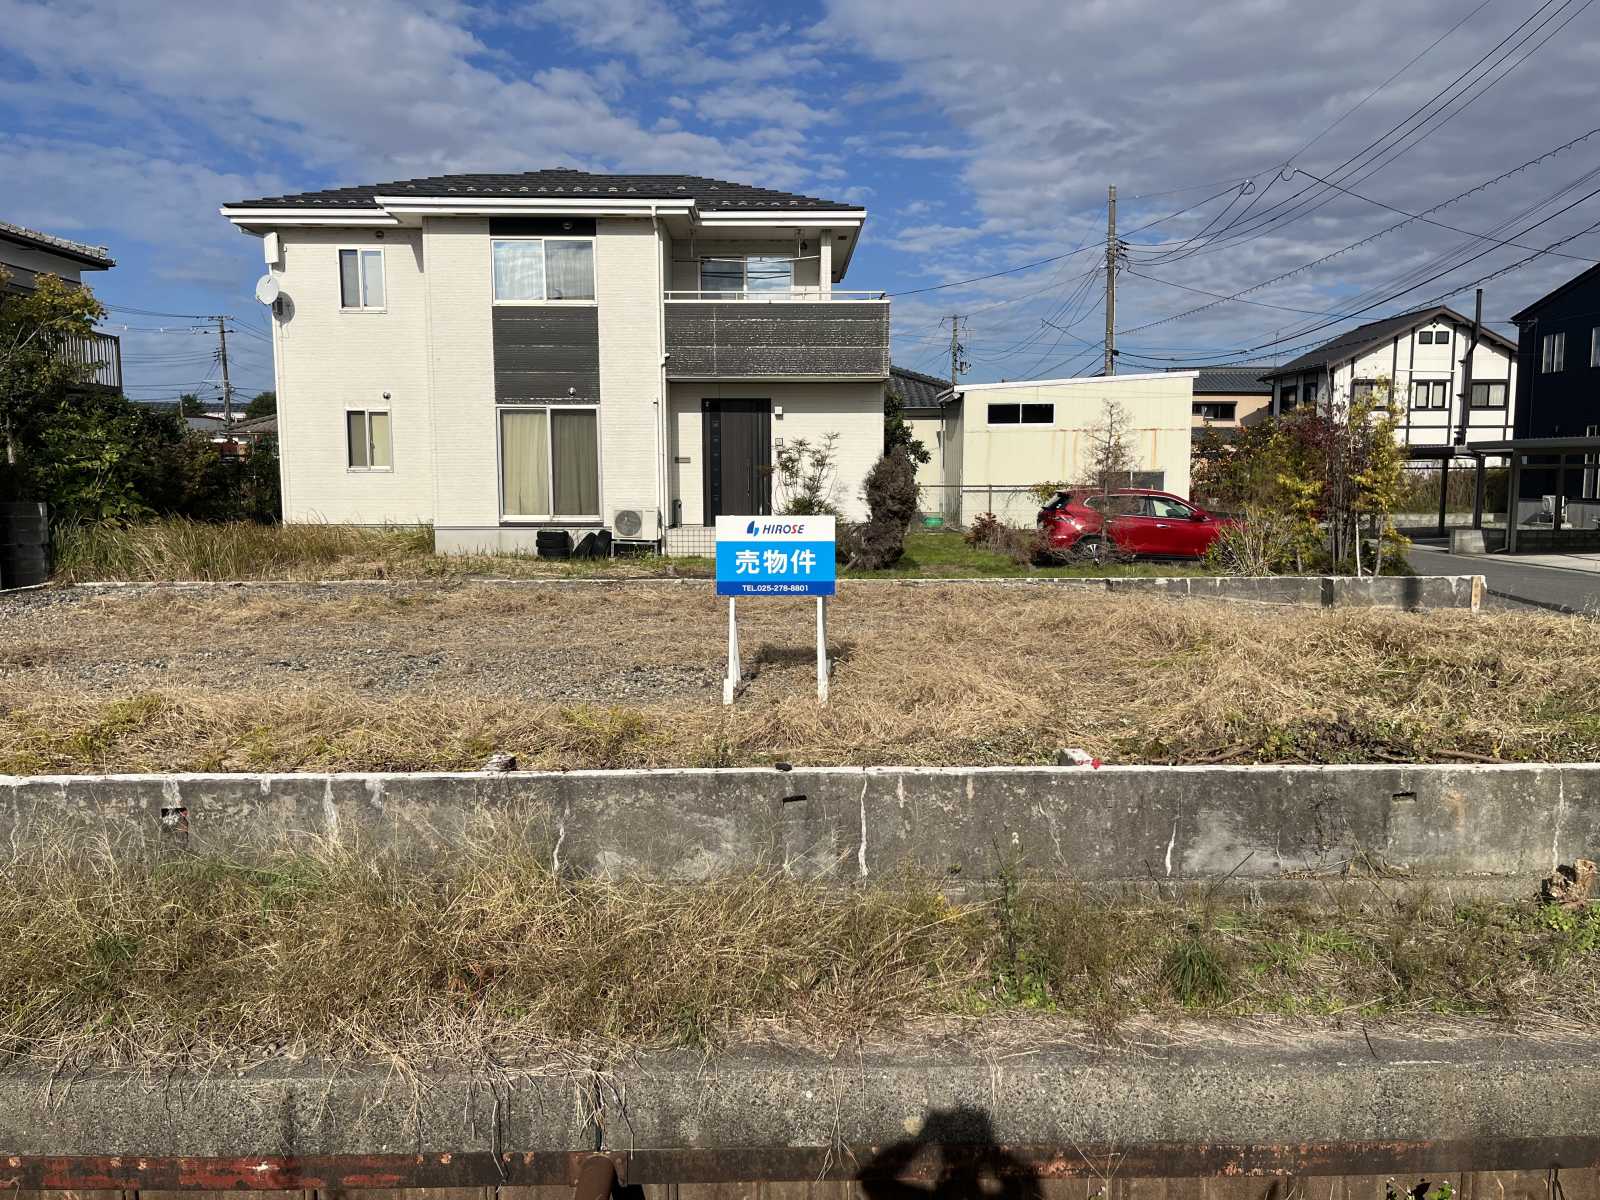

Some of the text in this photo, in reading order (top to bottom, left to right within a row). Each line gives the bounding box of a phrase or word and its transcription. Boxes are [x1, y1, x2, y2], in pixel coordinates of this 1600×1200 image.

[762, 524, 805, 534] HIROSE
[735, 549, 817, 574] 売物件
[742, 584, 808, 592] TEL.025-278-8801
